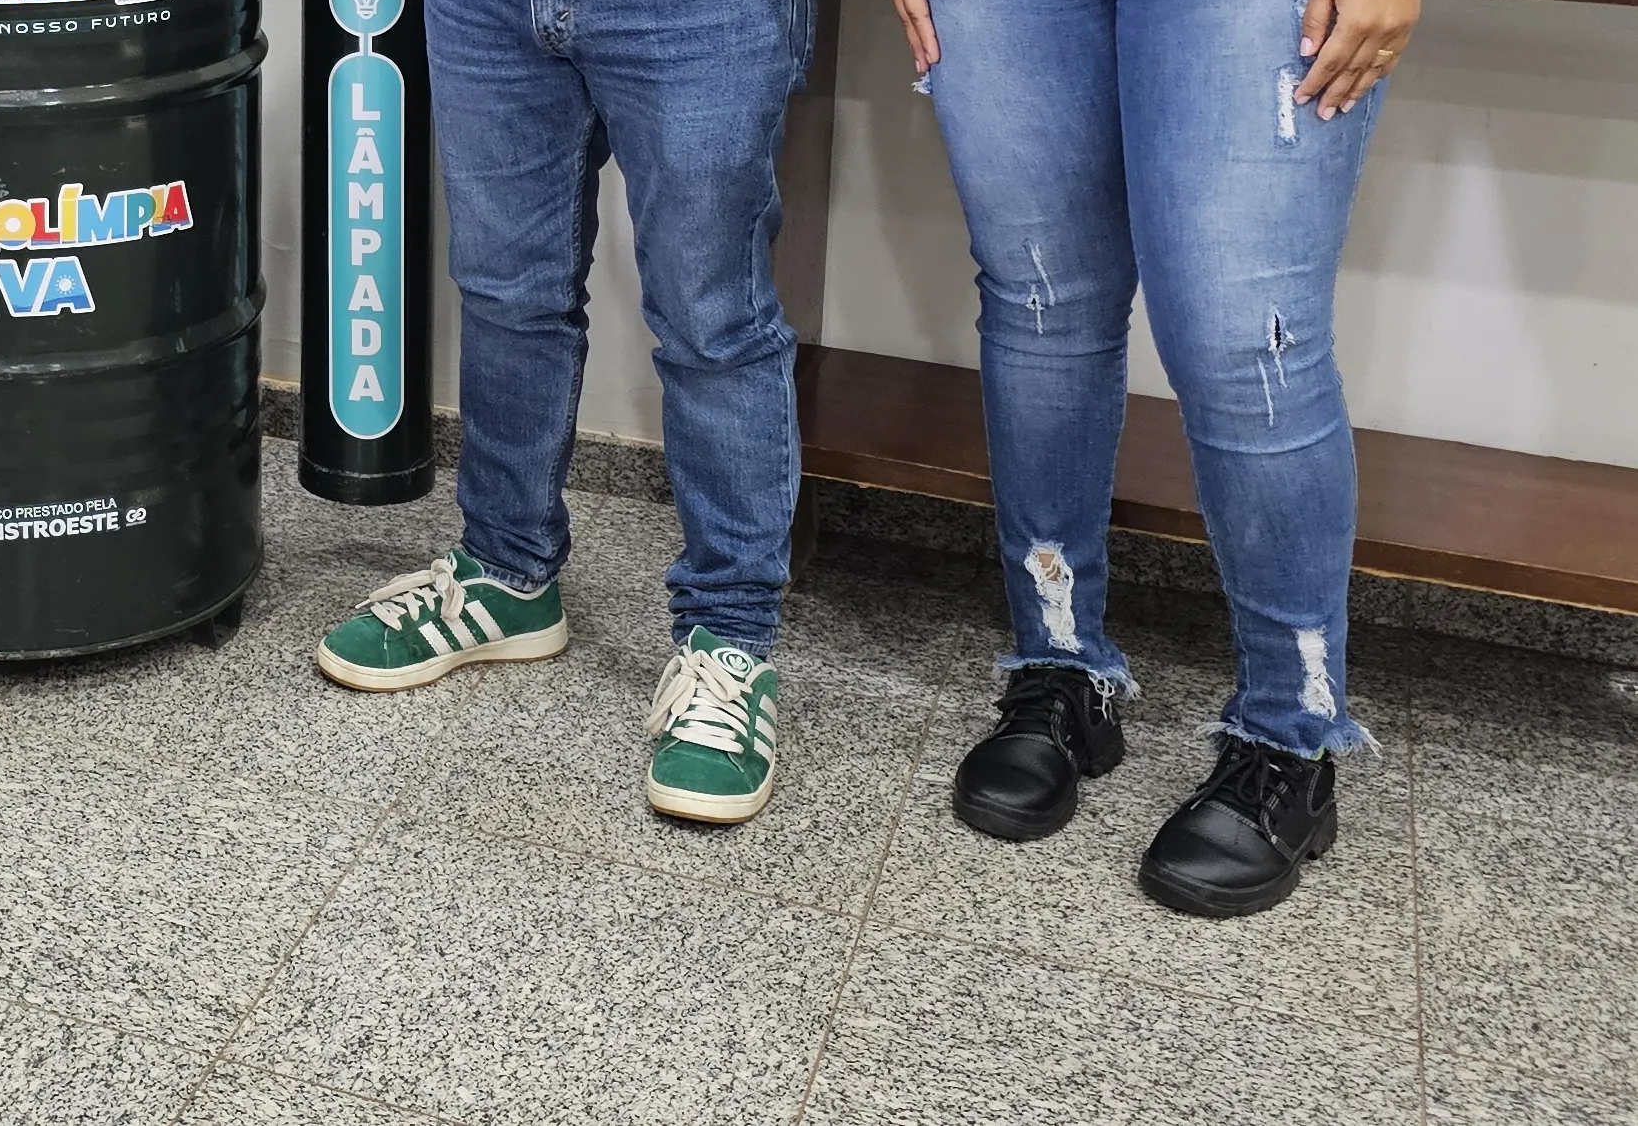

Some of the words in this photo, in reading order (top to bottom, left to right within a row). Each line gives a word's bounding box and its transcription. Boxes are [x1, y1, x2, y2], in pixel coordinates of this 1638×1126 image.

[0, 20, 78, 34] NOSSO
[92, 11, 170, 29] FUTURO
[348, 84, 384, 401] LÂMPADA
[16, 503, 83, 518] PRESTADO
[86, 498, 117, 512] PELA
